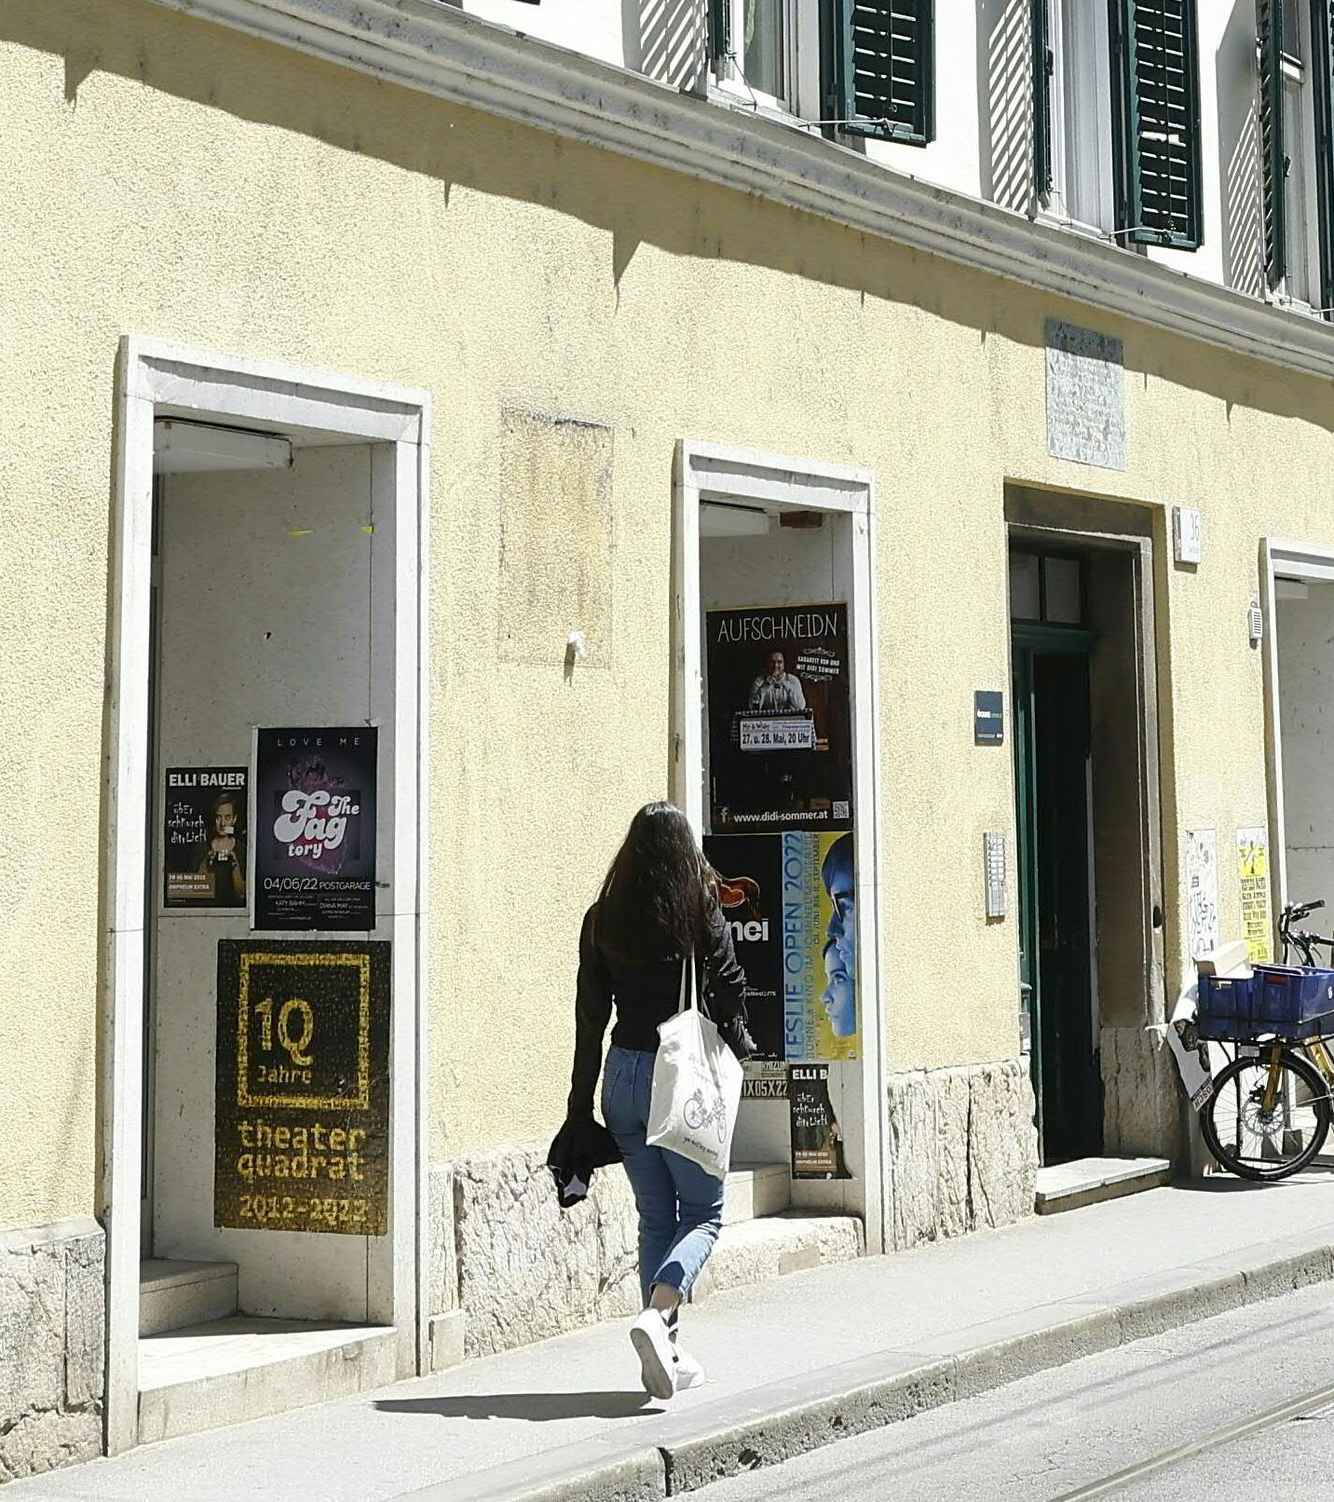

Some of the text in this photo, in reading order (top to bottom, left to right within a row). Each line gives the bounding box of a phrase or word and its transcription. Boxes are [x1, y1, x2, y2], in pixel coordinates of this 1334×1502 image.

[717, 613, 839, 643] AUFSCHNEIDN
[277, 737, 360, 747] LOVE ME
[798, 733, 809, 743] Uhr
[169, 773, 245, 787] ELLI BAUER
[327, 795, 360, 817] The
[733, 809, 829, 823] www.didi-sommer.at
[288, 841, 323, 859] tory
[263, 878, 372, 892] 04/06/22 POSTGARAGE
[784, 902, 804, 973] OPEN
[784, 983, 805, 1059] LESLIE
[257, 1065, 312, 1086] Jahre
[792, 1069, 817, 1080] ELLI
[238, 1119, 367, 1151] theater
[237, 1148, 365, 1184] quadrat
